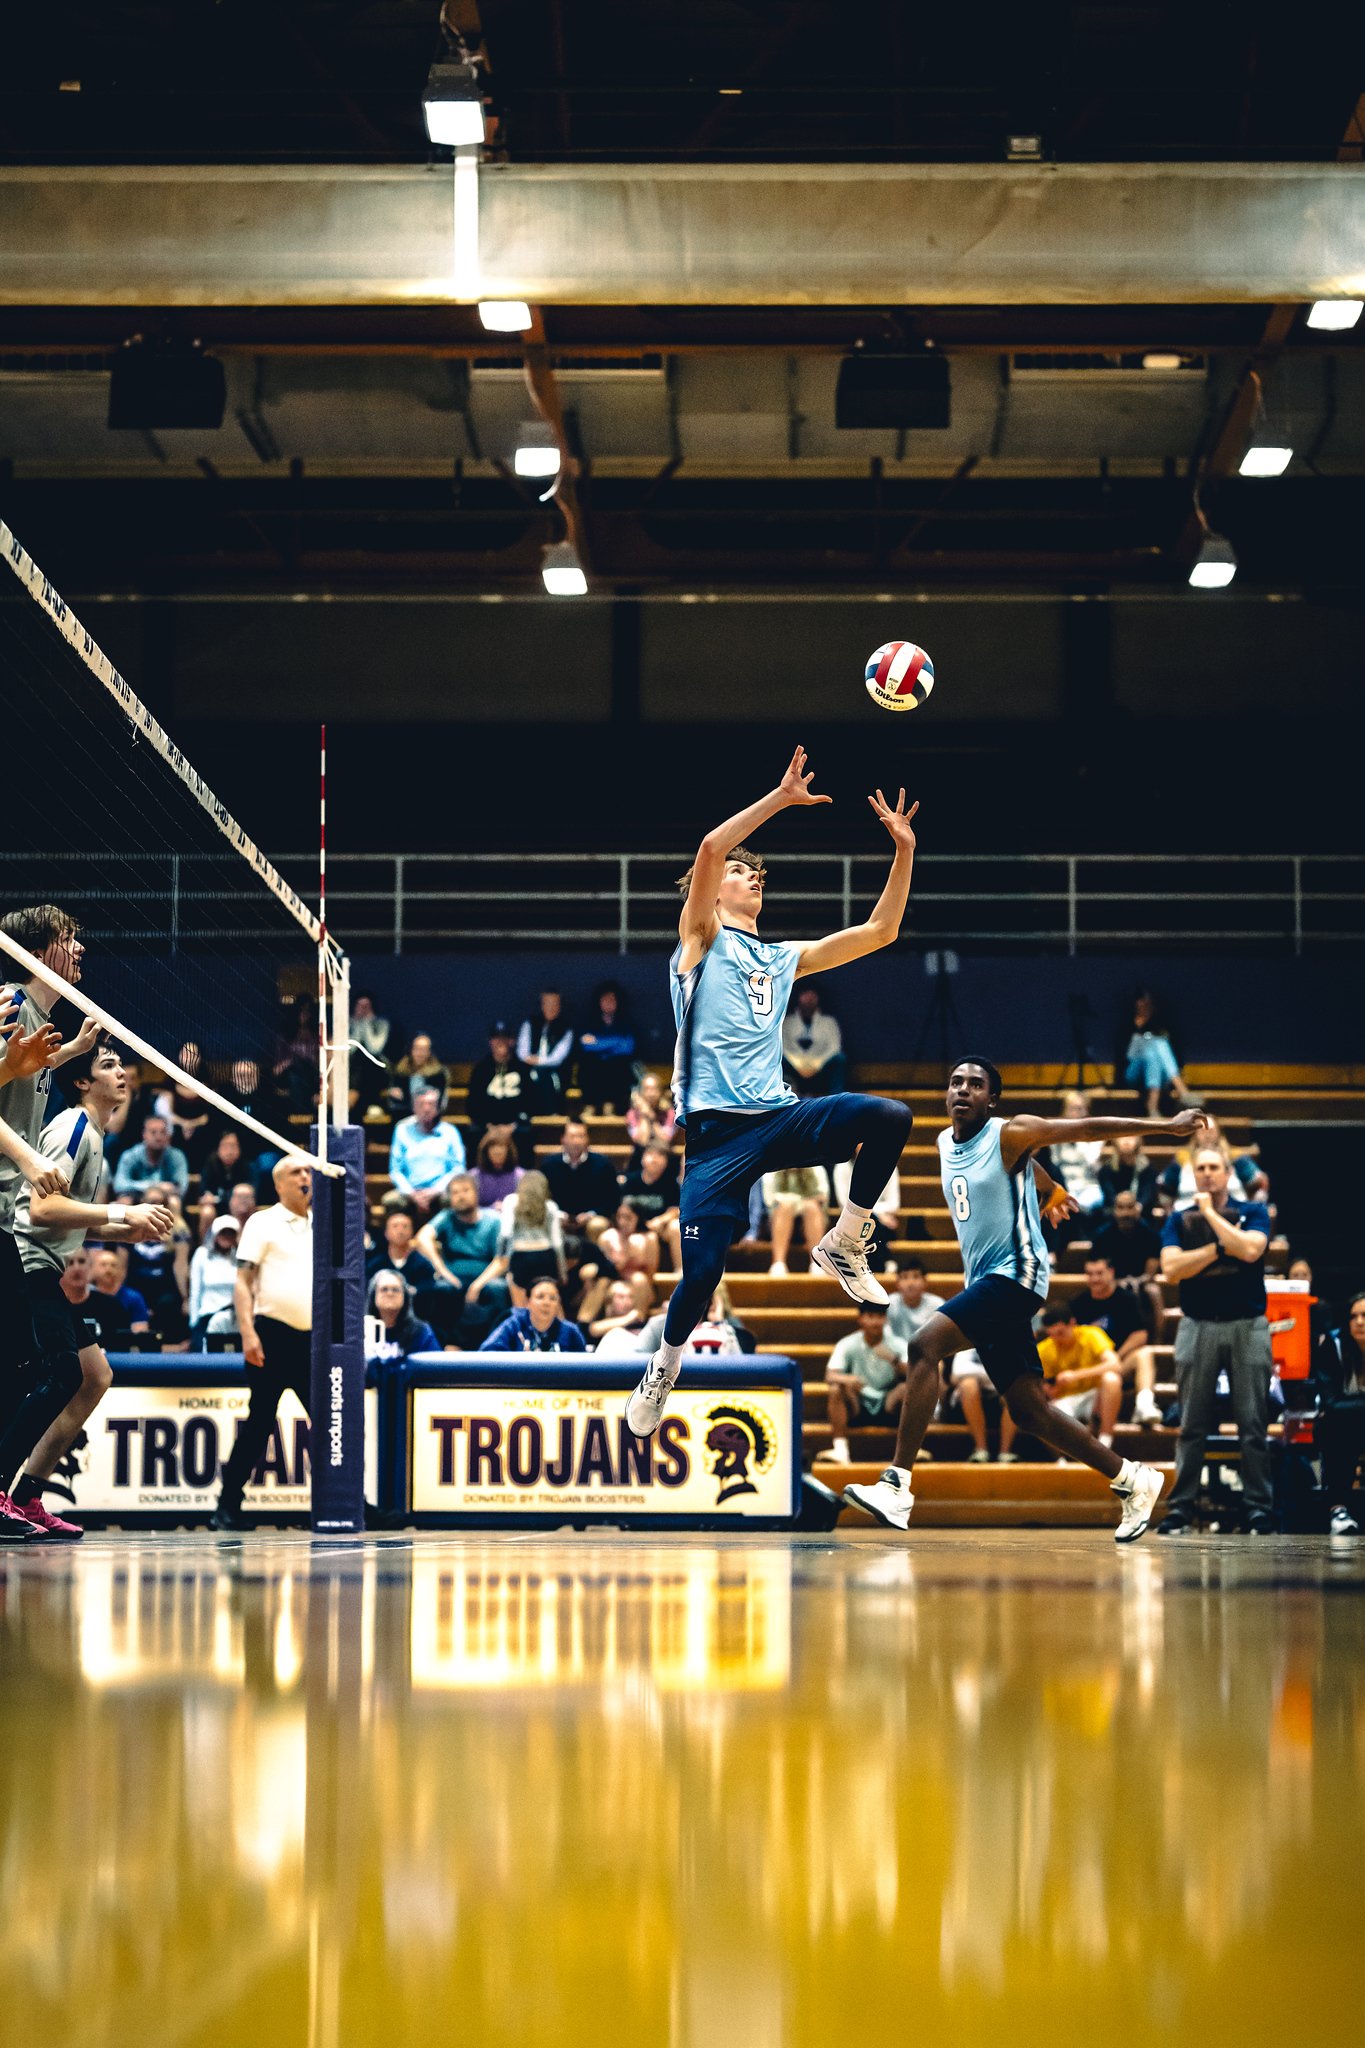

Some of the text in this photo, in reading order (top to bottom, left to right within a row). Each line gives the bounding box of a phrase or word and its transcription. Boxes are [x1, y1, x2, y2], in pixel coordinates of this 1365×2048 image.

[875, 687, 904, 703] Wilson
[749, 970, 774, 1016] 9
[951, 1175, 971, 1222] 8
[179, 1397, 222, 1409] HOME
[552, 1399, 570, 1410] OF
[577, 1398, 604, 1410] THE
[328, 1366, 344, 1466] sports imports
[430, 1415, 690, 1487] TROJANS
[139, 1494, 191, 1504] DONATED
[463, 1494, 516, 1504] DONATED
[538, 1494, 582, 1504] TROJAN
[585, 1494, 645, 1504] BOOSTERS
